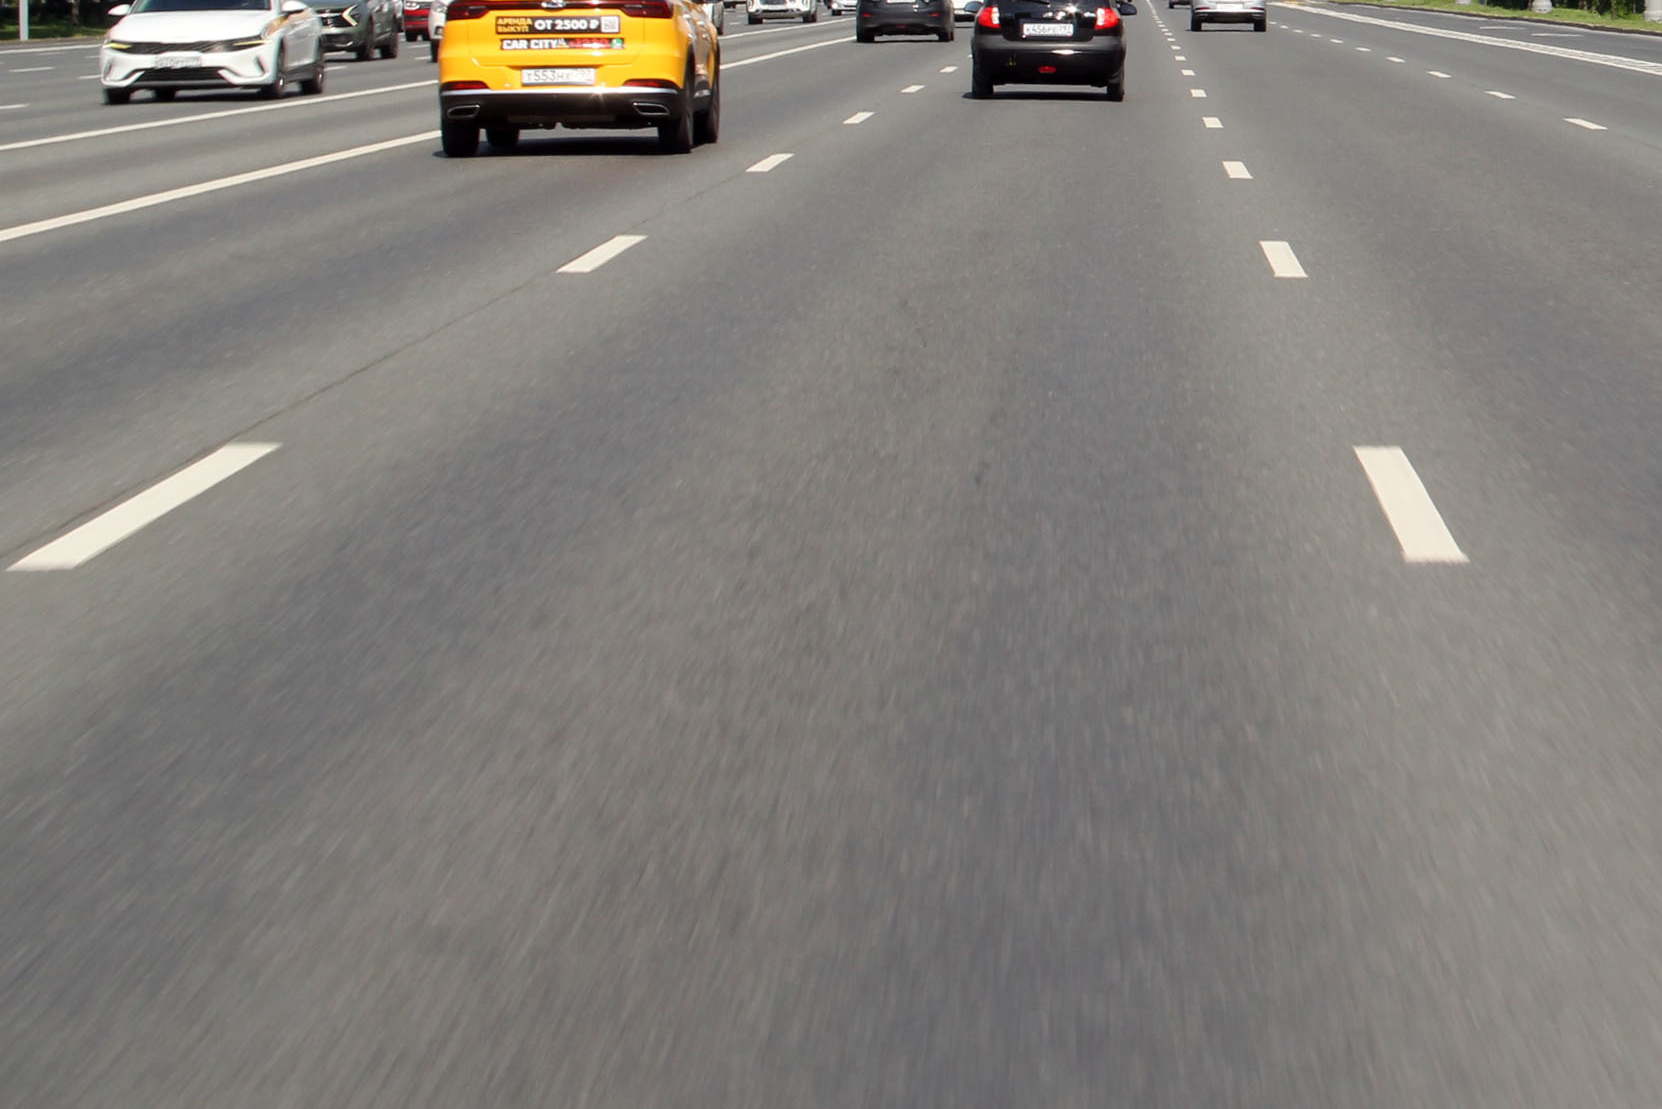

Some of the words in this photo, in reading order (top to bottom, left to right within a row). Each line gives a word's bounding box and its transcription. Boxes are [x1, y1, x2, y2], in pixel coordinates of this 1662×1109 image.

[497, 17, 532, 25] АРЕНДА
[534, 19, 553, 30] ОТ
[554, 19, 588, 30] 2500
[502, 39, 528, 50] CAR
[529, 38, 558, 49] CITY
